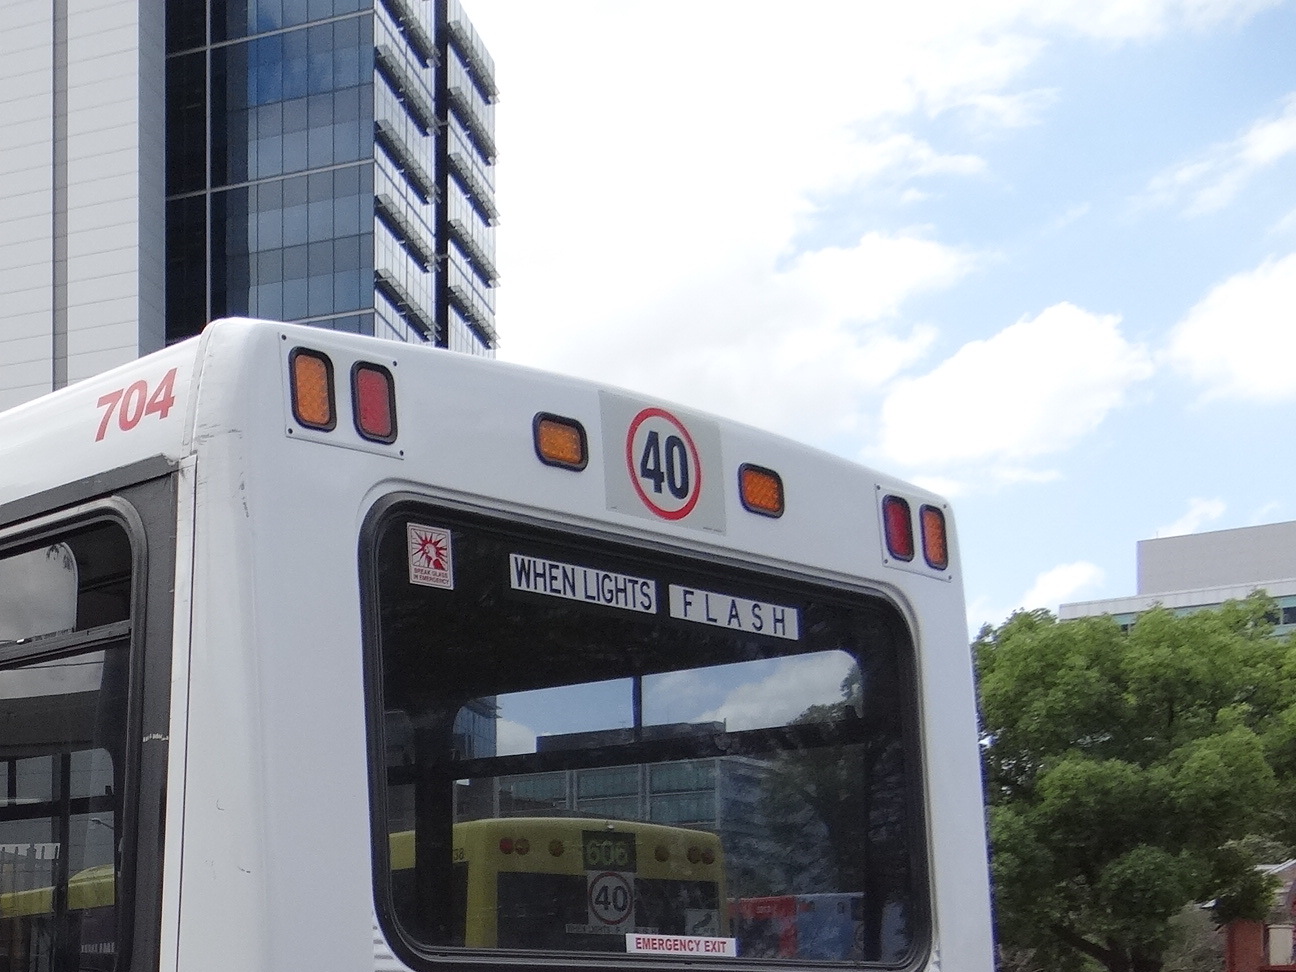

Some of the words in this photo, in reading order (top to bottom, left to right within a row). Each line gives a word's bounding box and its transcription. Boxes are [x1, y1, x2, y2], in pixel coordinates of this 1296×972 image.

[95, 367, 178, 442] 704
[640, 430, 689, 500] 40
[513, 556, 577, 598] WHEN
[583, 569, 652, 611] LIGHTS
[682, 589, 787, 636] FLASH
[594, 885, 628, 913] 40
[635, 937, 701, 952] EMERGENCY
[704, 940, 727, 953] EXIT
